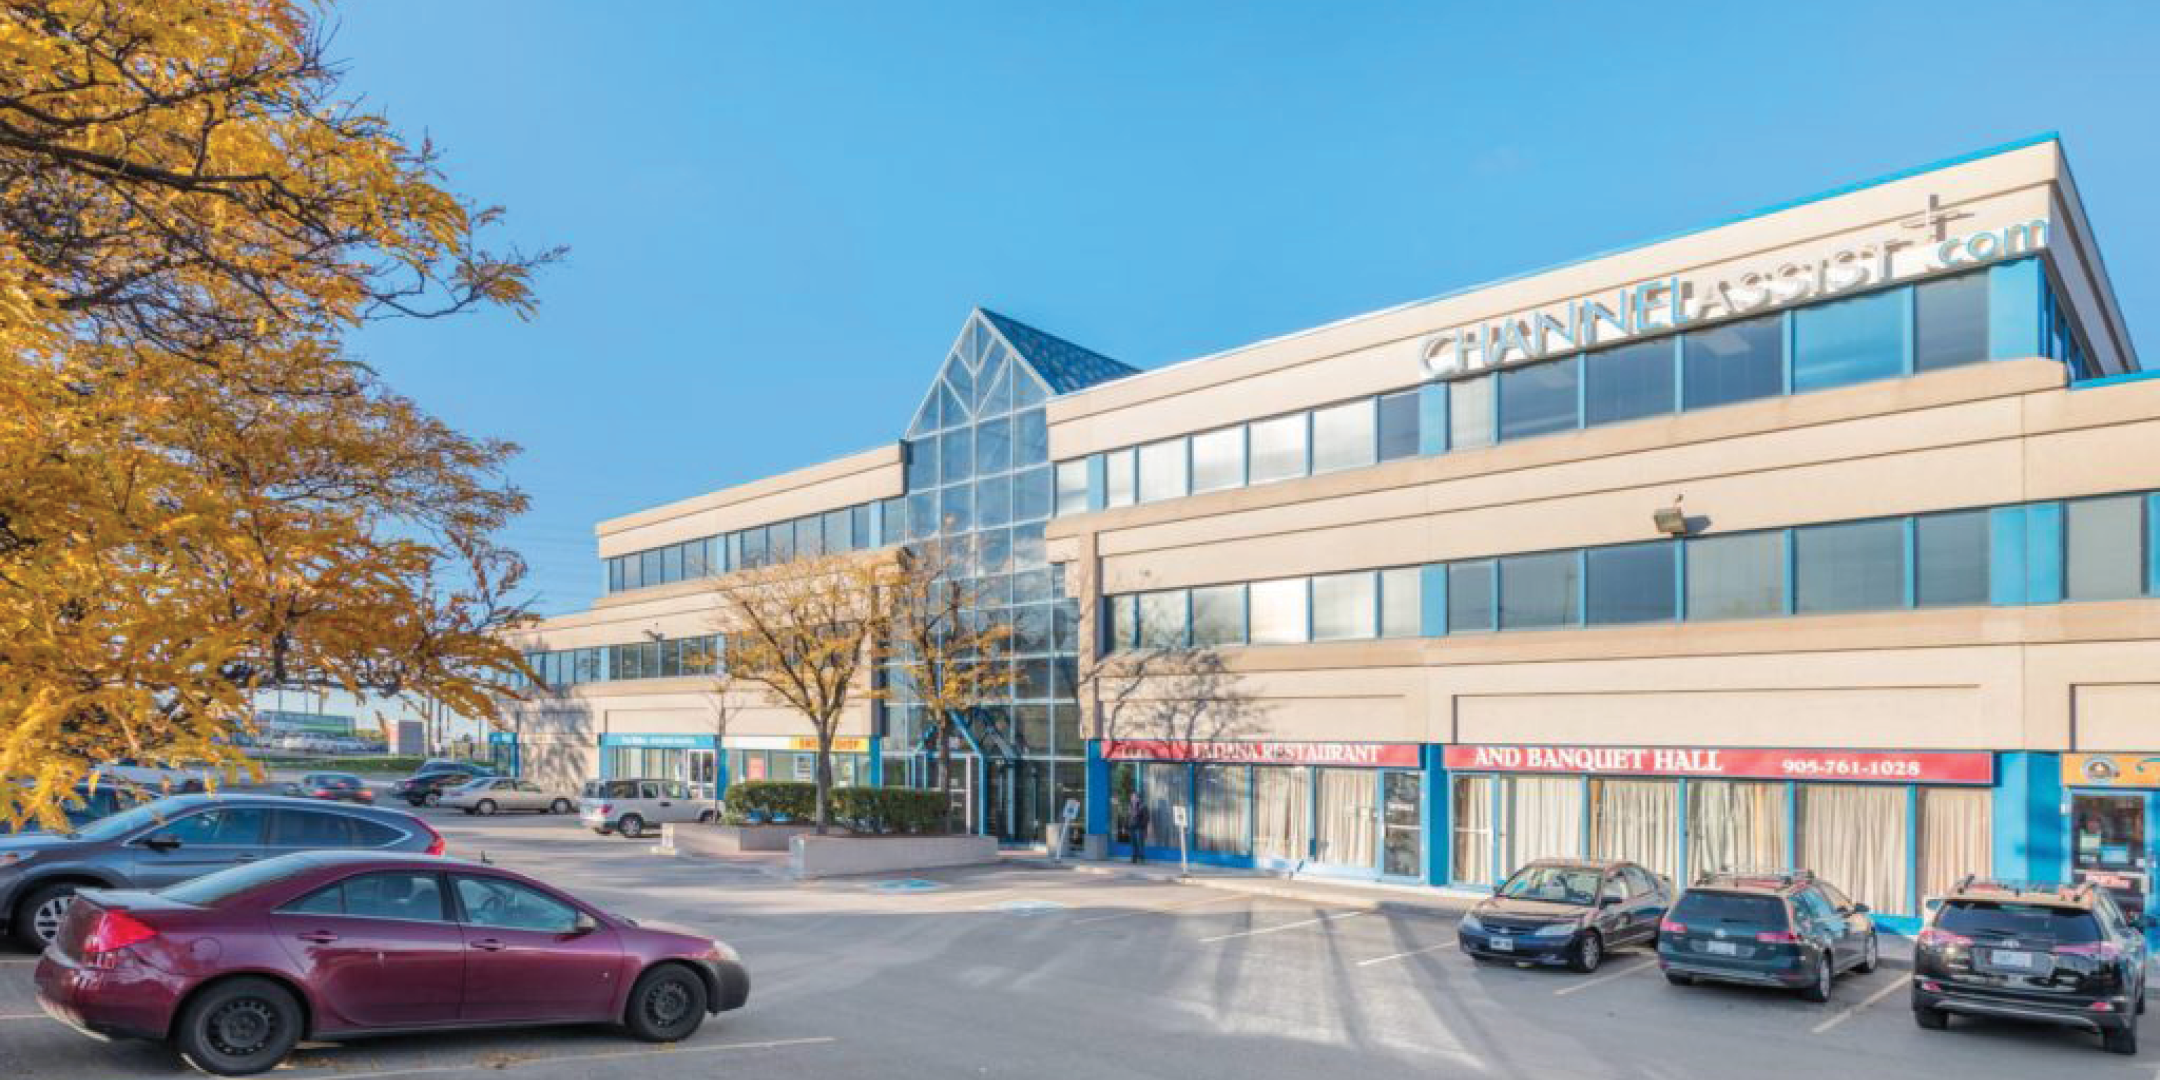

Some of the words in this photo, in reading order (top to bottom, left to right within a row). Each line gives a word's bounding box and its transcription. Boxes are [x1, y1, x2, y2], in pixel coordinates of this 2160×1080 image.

[1418, 276, 1688, 378] CHANNEL
[1263, 742, 1384, 764] RESTAURANT
[1475, 747, 1521, 767] AND
[1526, 748, 1647, 771] BANQUET
[1653, 749, 1722, 771] HALL
[1782, 759, 1920, 775] 905-761-1028
